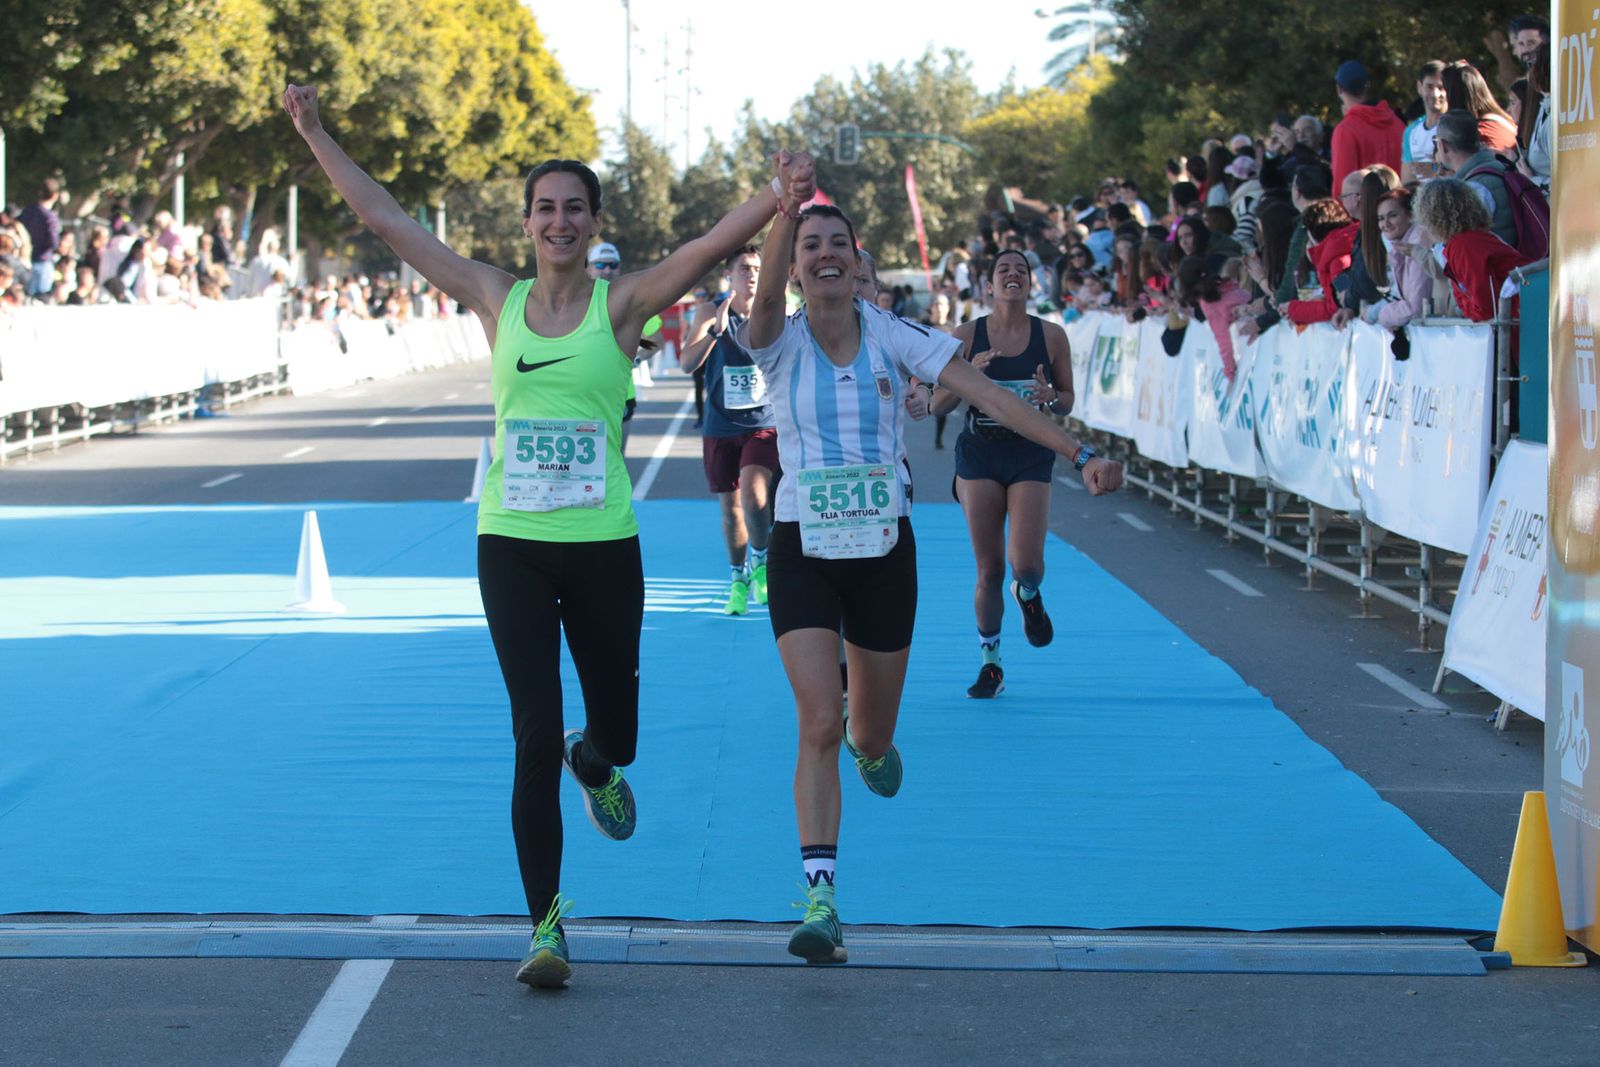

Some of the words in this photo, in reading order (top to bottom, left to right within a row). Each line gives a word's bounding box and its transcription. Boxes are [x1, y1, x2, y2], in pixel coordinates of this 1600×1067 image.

[517, 436, 596, 464] 5593
[537, 463, 570, 471] MARIAN
[810, 481, 890, 512] 5516
[820, 511, 839, 520] FLIA
[841, 508, 880, 518] TORTUGA
